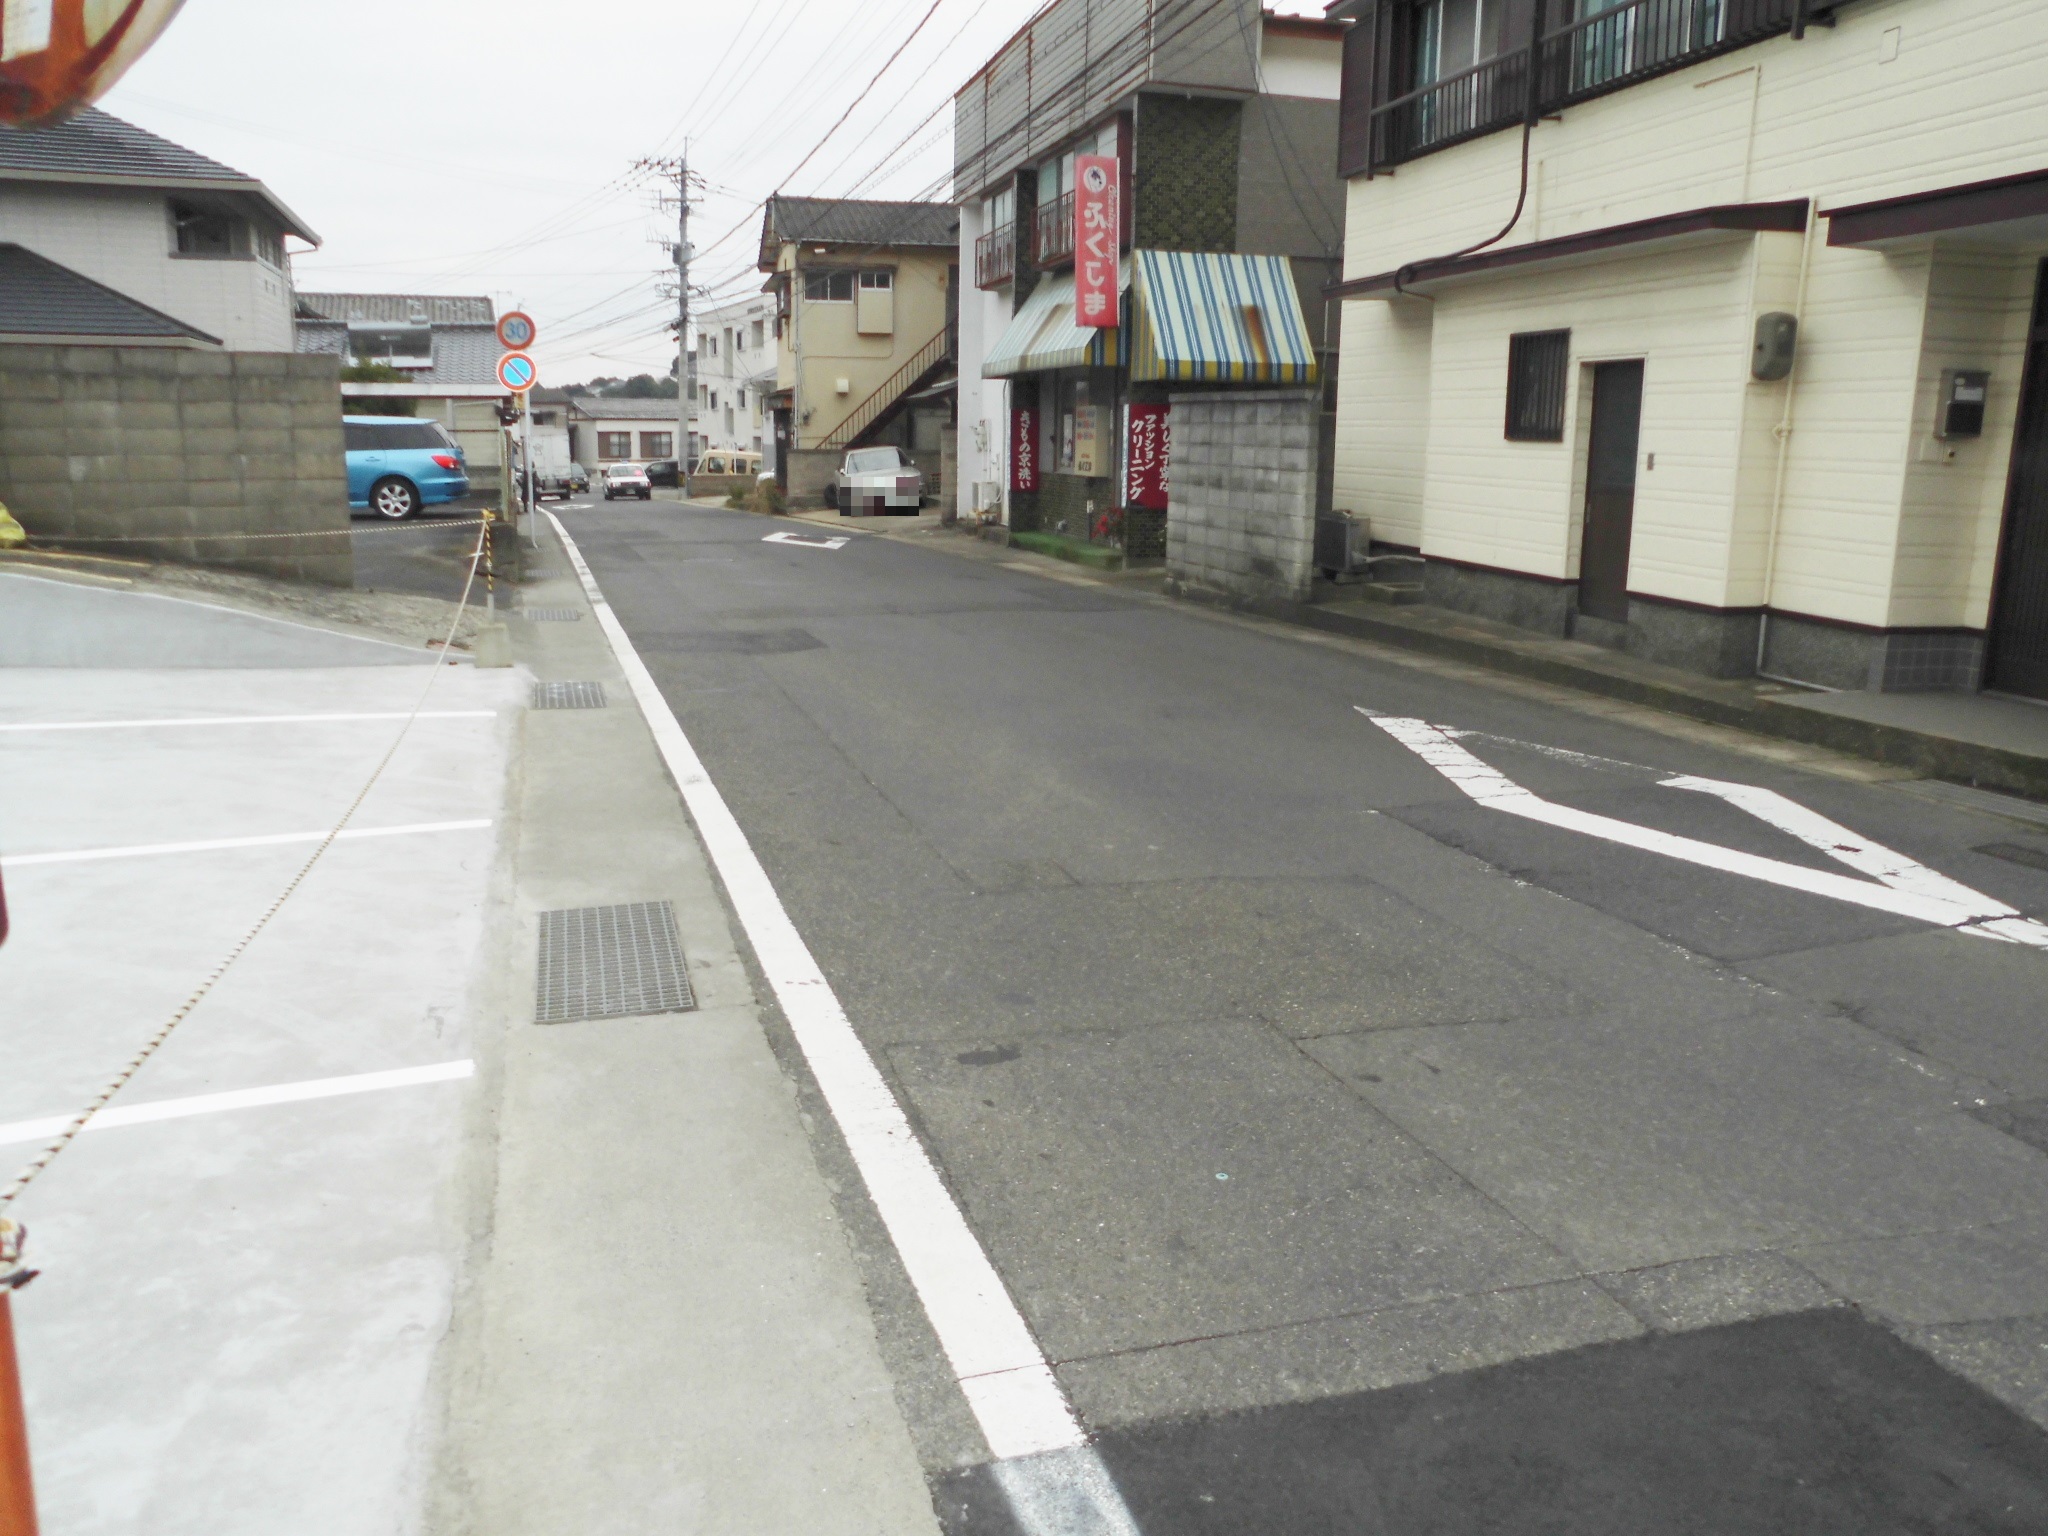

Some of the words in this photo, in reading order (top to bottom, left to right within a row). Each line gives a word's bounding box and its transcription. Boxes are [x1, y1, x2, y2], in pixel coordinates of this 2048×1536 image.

[1083, 201, 1107, 315] ふくしま
[505, 321, 528, 340] 30
[1130, 419, 1145, 500] クリーニング
[1144, 414, 1157, 470] ファッション
